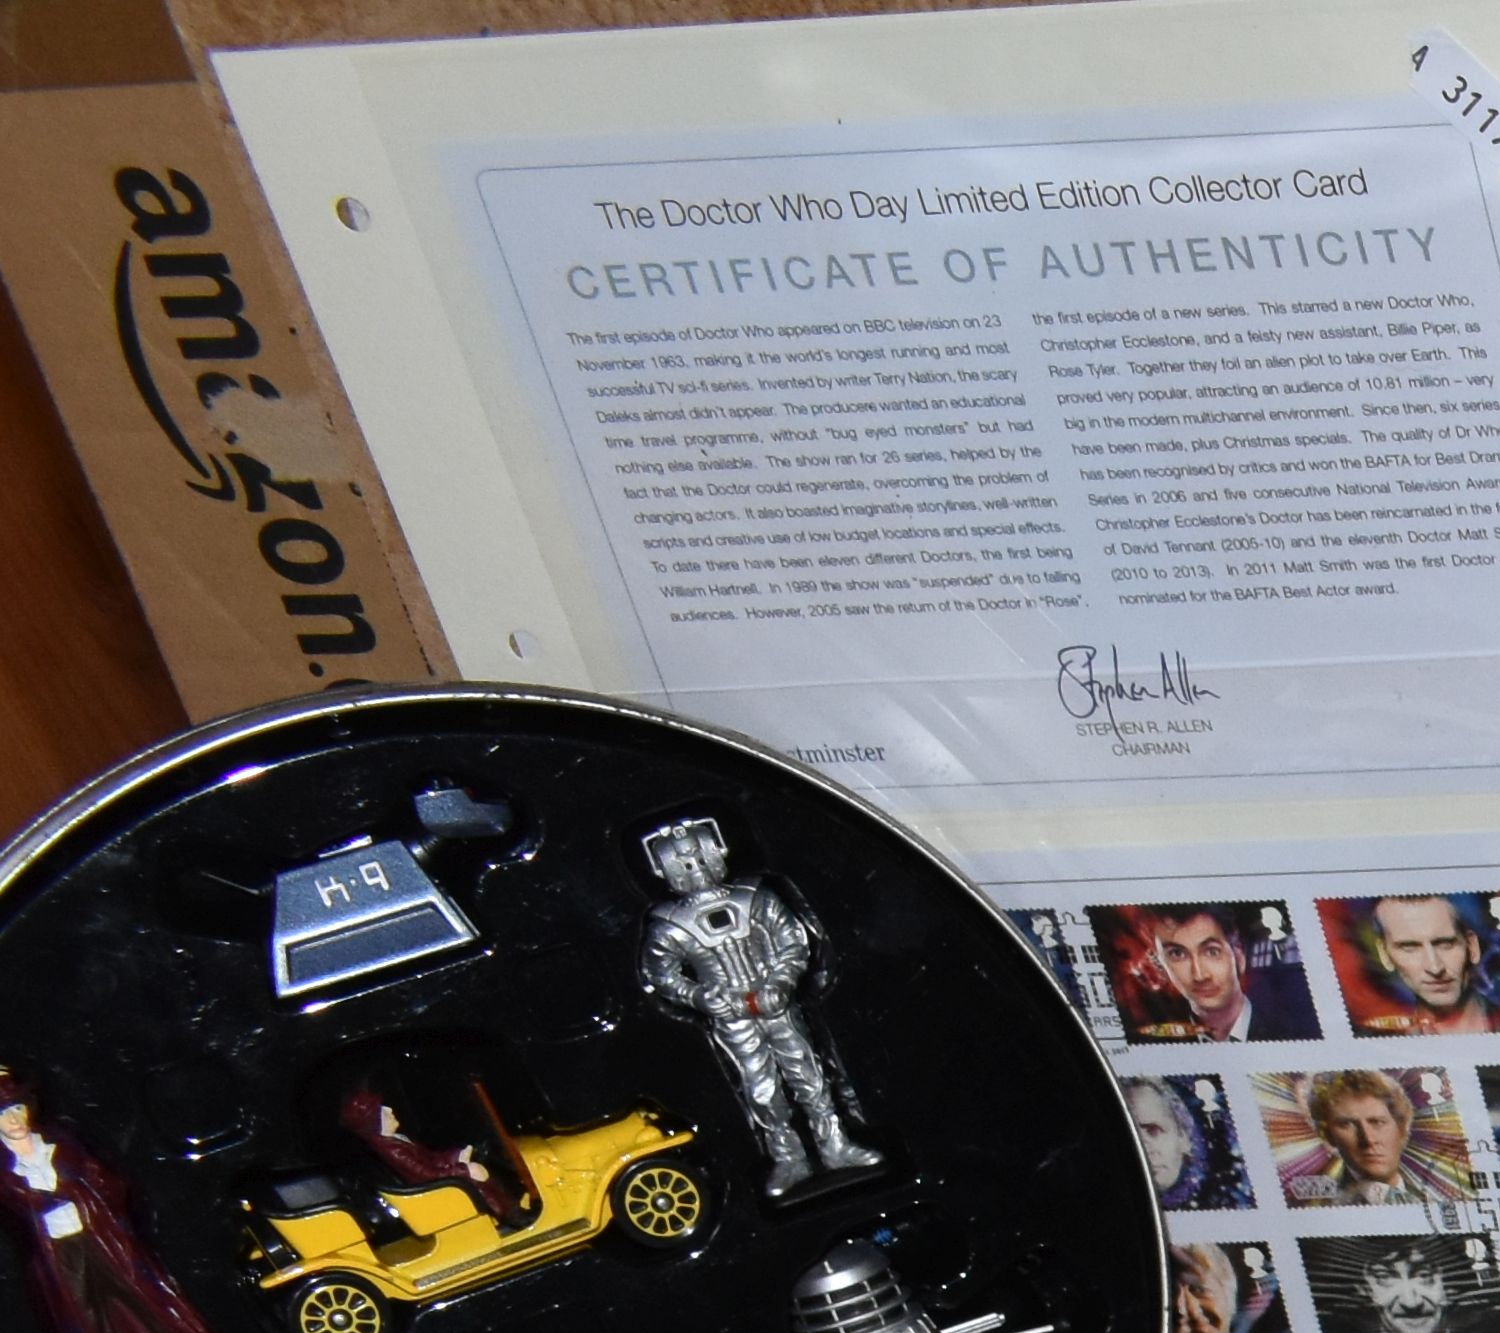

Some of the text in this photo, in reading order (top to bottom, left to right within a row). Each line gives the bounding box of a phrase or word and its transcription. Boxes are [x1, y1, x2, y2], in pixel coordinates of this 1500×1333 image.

[1410, 45, 1430, 73] A
[594, 168, 1368, 229] The Doctor Who Day Limited Edition Collector Card
[567, 227, 1434, 300] CERTIFICATE OF AUTHENTICITY
[567, 314, 1002, 347] The first episode of Doctor Who appeared on BBC television on 23
[1076, 720, 1147, 737] STEPHEN
[1164, 718, 1214, 735] ALLEN
[1112, 742, 1190, 757] CHAIRMAN
